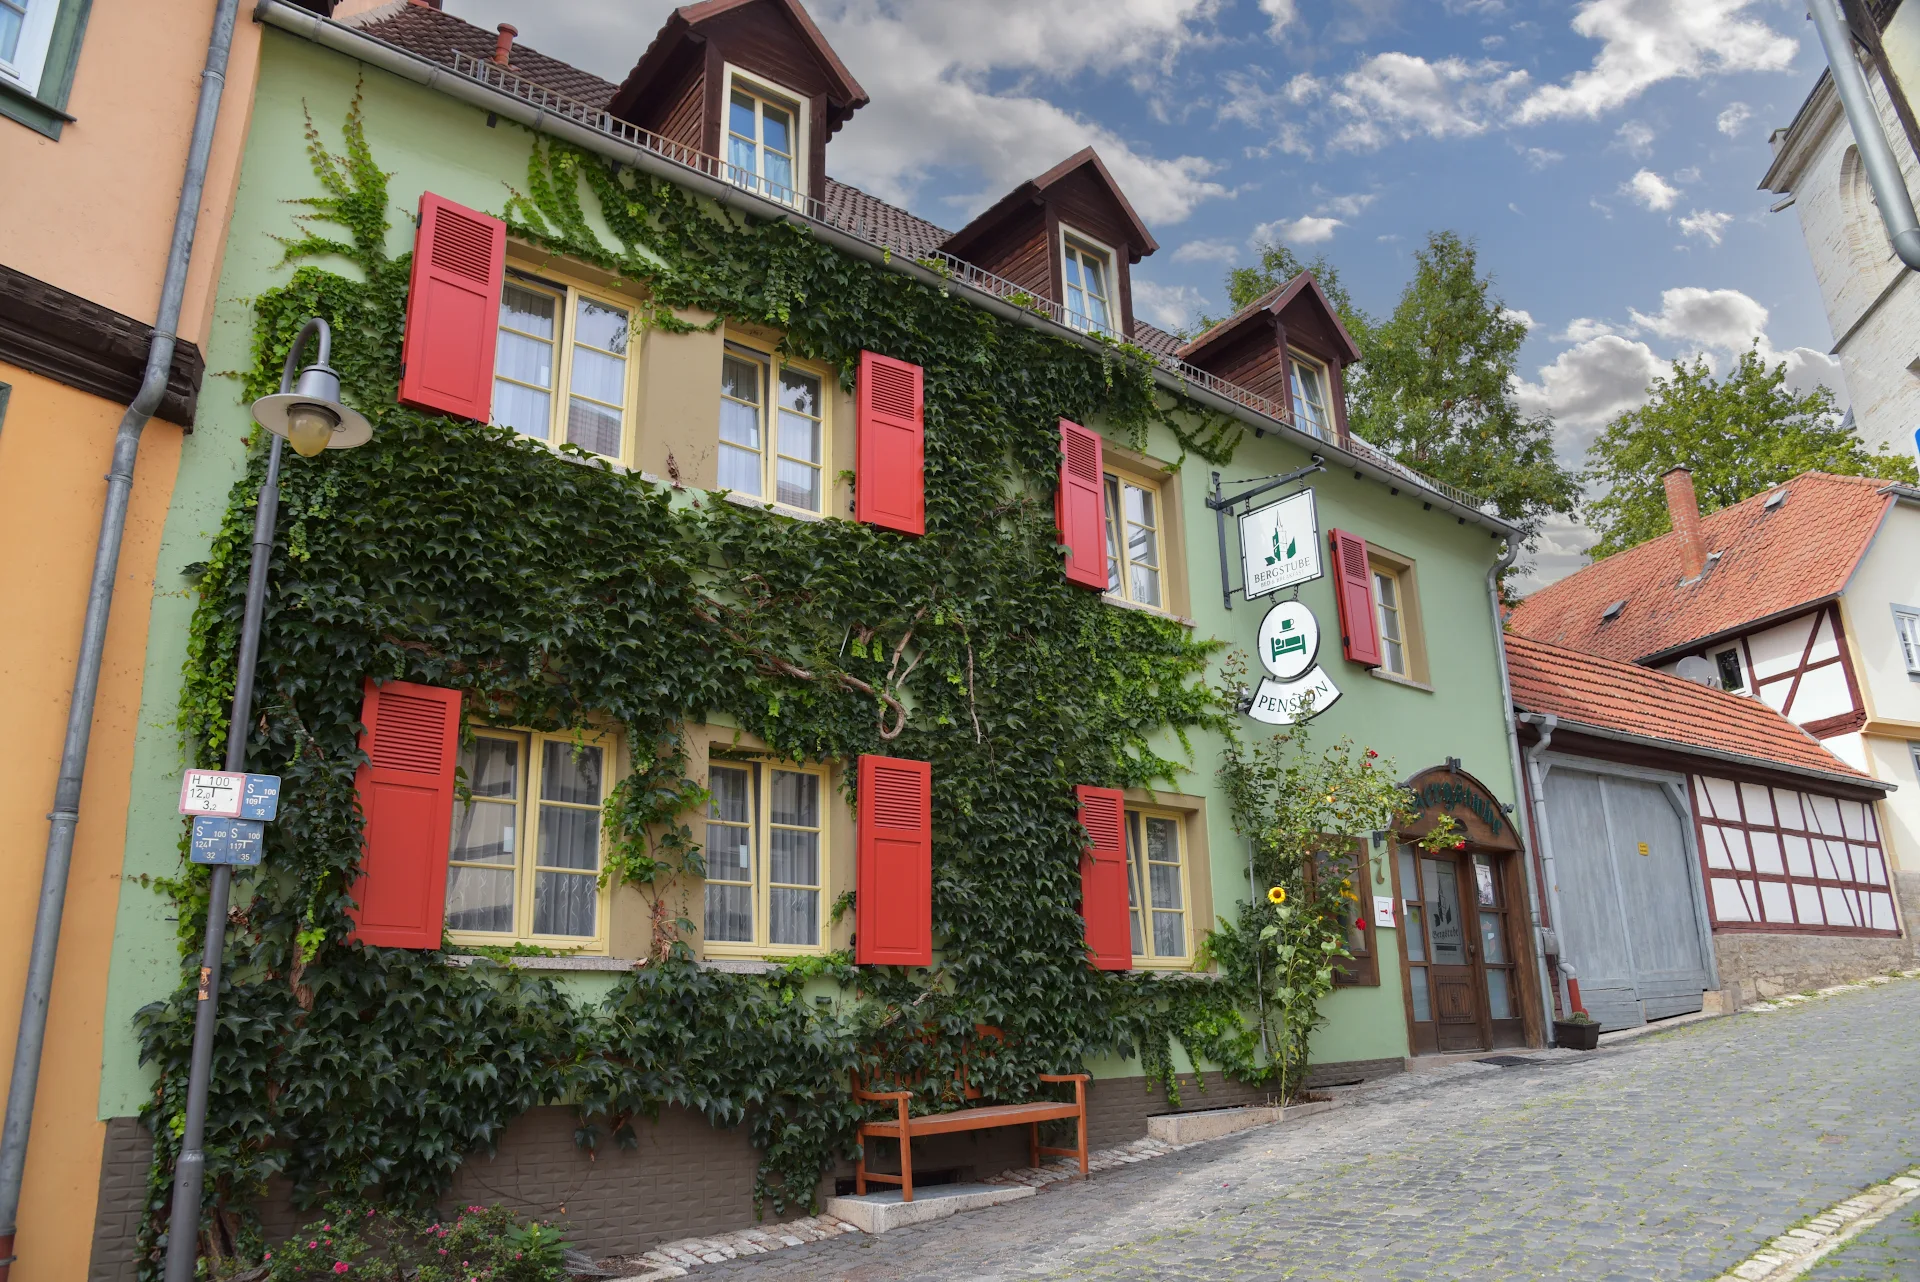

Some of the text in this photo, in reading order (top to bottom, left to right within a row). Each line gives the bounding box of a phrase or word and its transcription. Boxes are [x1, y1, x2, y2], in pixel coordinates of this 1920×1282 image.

[1254, 556, 1311, 584] BERGSTUBE
[210, 776, 230, 786] 100
[246, 784, 254, 794] S
[196, 826, 204, 836] S
[231, 828, 238, 838] S
